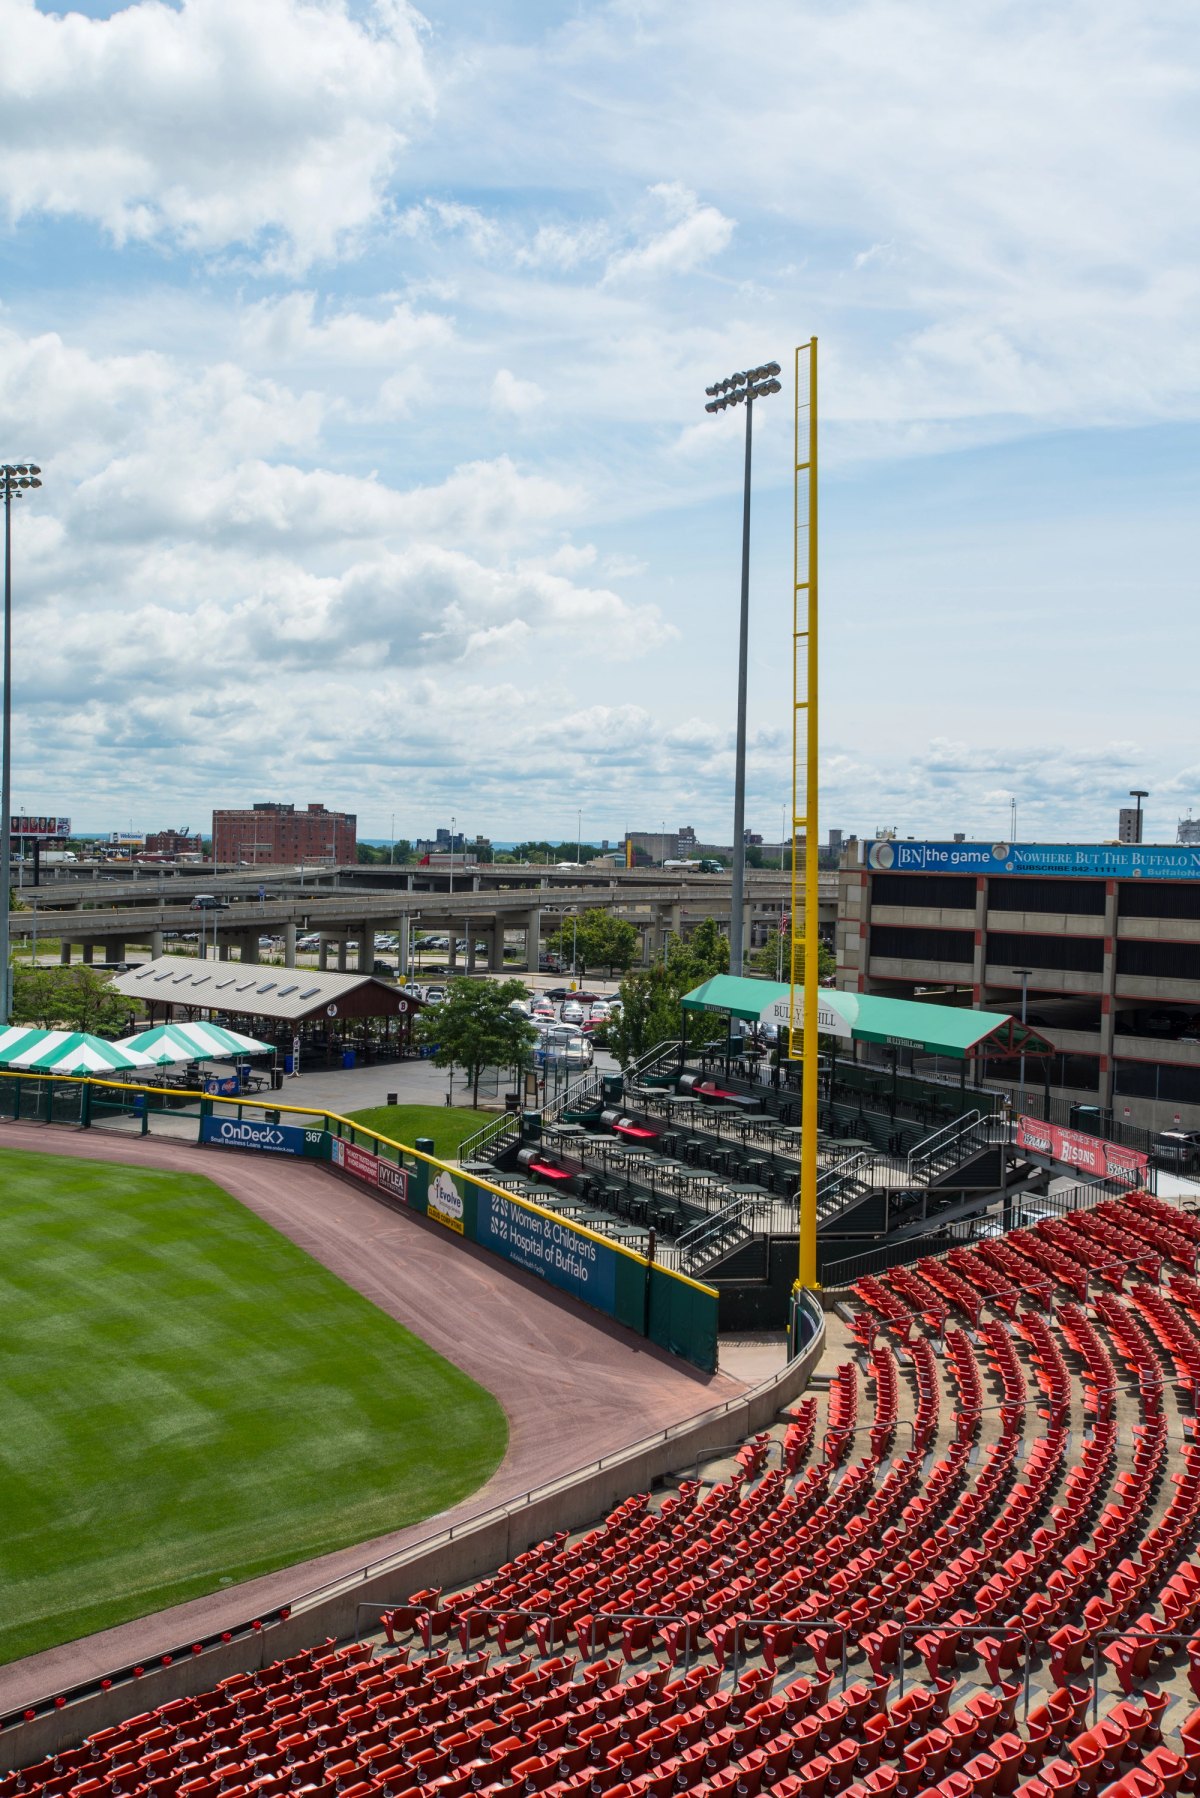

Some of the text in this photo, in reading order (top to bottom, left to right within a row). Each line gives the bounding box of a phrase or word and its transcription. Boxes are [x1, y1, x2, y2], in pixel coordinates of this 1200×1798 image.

[926, 848, 948, 862] the
[950, 851, 990, 864] game
[1014, 850, 1073, 864] NOWHERE
[1102, 852, 1129, 865] THE
[1132, 852, 1188, 866] BUFFALO
[774, 1005, 802, 1020] BULY
[210, 1136, 224, 1144] Small
[225, 1138, 246, 1147] Business
[246, 1141, 261, 1149] Loans
[221, 1122, 275, 1144] OnDeck
[305, 1131, 322, 1143] 367
[1084, 1137, 1089, 1145] OF
[1090, 1138, 1100, 1149] THE
[1060, 1140, 1095, 1166] BISONS
[380, 1166, 391, 1182] IVY
[390, 1171, 404, 1189] LEA
[429, 1207, 462, 1231] CLOUD COMPUTING
[510, 1203, 596, 1262] Women & Children's
[509, 1225, 588, 1281] Hospital of Buffalo
